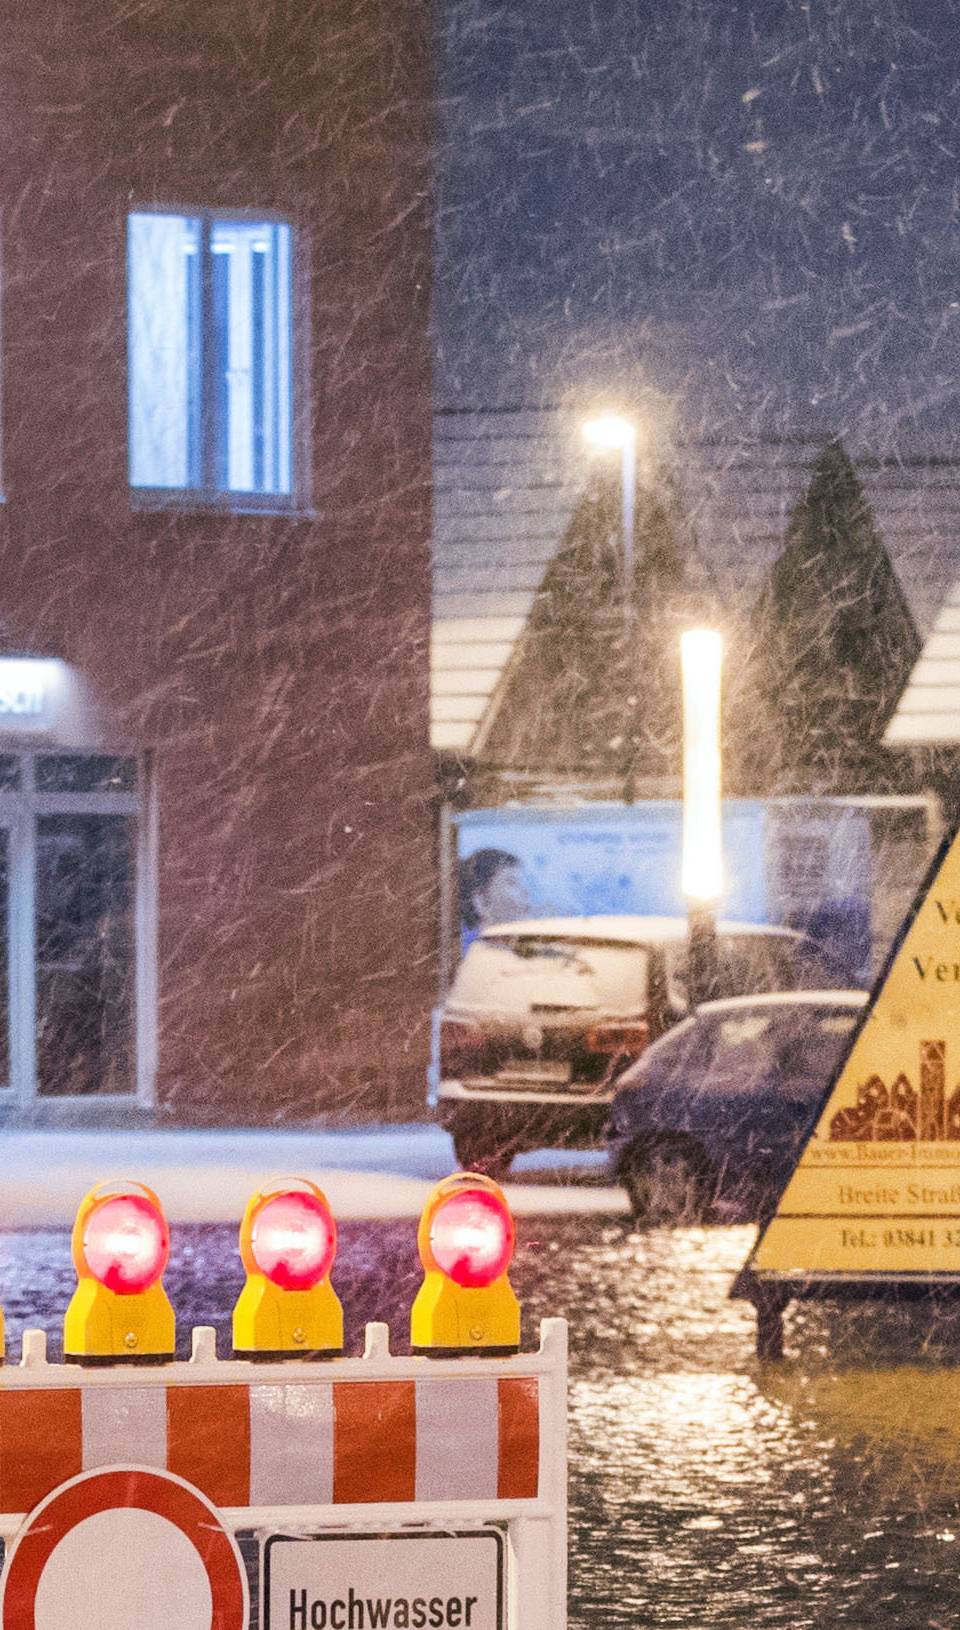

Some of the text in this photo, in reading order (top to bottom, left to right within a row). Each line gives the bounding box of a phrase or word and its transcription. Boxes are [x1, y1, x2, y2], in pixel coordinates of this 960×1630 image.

[838, 1184, 899, 1205] Breite
[882, 1229, 934, 1248] 03841
[289, 1587, 478, 1630] Hochwasser
